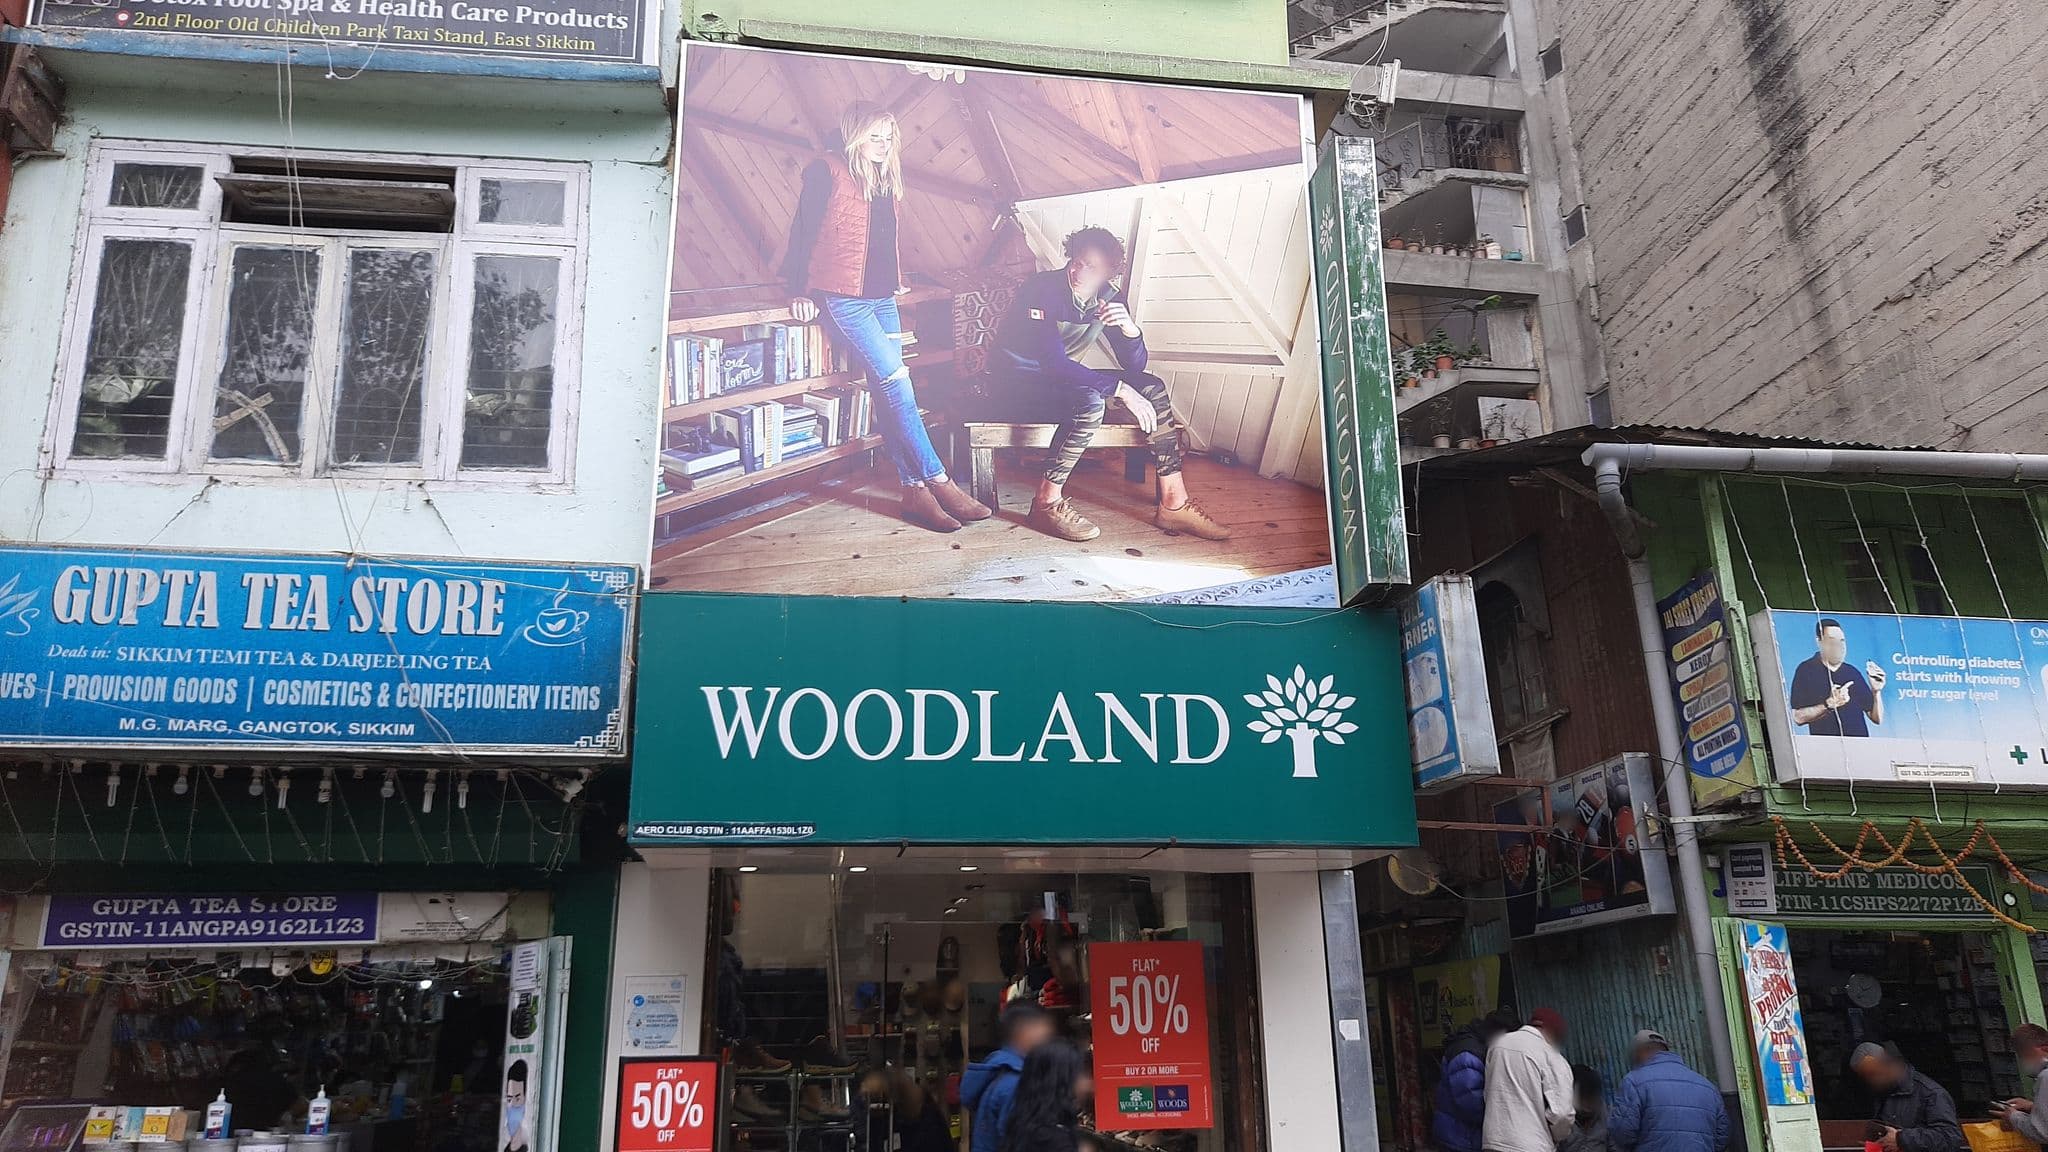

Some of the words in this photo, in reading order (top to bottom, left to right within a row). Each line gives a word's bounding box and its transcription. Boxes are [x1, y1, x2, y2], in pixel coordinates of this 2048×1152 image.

[331, 0, 351, 13] &
[358, 0, 443, 18] Health
[451, 3, 509, 22] Care
[516, 8, 629, 30] Products
[133, 12, 169, 27] 2nd
[174, 14, 223, 30] Floor
[228, 17, 259, 32] Old
[264, 18, 341, 37] Children
[346, 23, 387, 39] Park
[392, 25, 429, 41] Taxi
[433, 28, 489, 47] Stand,
[494, 32, 531, 47] East
[537, 34, 596, 51] Sikkim
[52, 564, 220, 628] GUPTA
[241, 571, 331, 631] TEA
[349, 575, 507, 637] STORE
[1400, 600, 1425, 629] OLL
[1402, 617, 1437, 650] RNER
[47, 643, 88, 659] Deals
[91, 645, 111, 659] in:
[115, 646, 192, 663] SIKKIM
[199, 648, 251, 665] TEMI
[252, 650, 296, 667] TEA
[302, 653, 317, 667] &
[322, 652, 451, 671] DARJEELING
[453, 655, 493, 671] TEA
[1690, 653, 1712, 674] XEROX
[1892, 652, 1967, 670] Controlling
[1968, 656, 2022, 670] diabetes
[1895, 671, 1932, 682] starts
[1933, 672, 1963, 684] with
[1964, 673, 2020, 688] knowing
[0, 672, 37, 699] VES
[63, 673, 169, 703] PROVISION
[172, 676, 238, 704] GOODS
[263, 679, 373, 708] COSMETICS
[378, 681, 391, 707] &
[395, 681, 541, 711] CONFECTIONERY
[544, 684, 601, 711] ITEMS
[1898, 687, 1929, 700] your
[1930, 690, 1967, 702] sugar
[1968, 689, 1999, 701] level
[119, 717, 161, 731] M.G.
[168, 719, 233, 735] MARG,
[239, 721, 342, 737] GANGTOK,
[348, 721, 415, 736] SIKKIM
[700, 685, 1231, 765] WOODLAND
[635, 826, 665, 835] AERO
[667, 826, 693, 834] CLUB
[696, 826, 724, 835] GSTIN
[1774, 871, 1871, 889] LIFE-LINE
[92, 899, 181, 916] GUPTA
[189, 897, 242, 914] TEA
[59, 917, 366, 939] GSTIN-11ANGPA9162L1Z3
[1109, 974, 1189, 1036] 50%
[1756, 974, 1794, 1026] PROVEN
[1141, 1037, 1160, 1053] OFF
[1125, 1067, 1141, 1076] BUY
[1141, 1067, 1146, 1075] 2
[1147, 1067, 1157, 1075] OR
[1158, 1065, 1179, 1075] MORE
[631, 1080, 704, 1129] 50%
[1157, 1098, 1188, 1109] WOODS
[657, 1129, 675, 1143] OFF
